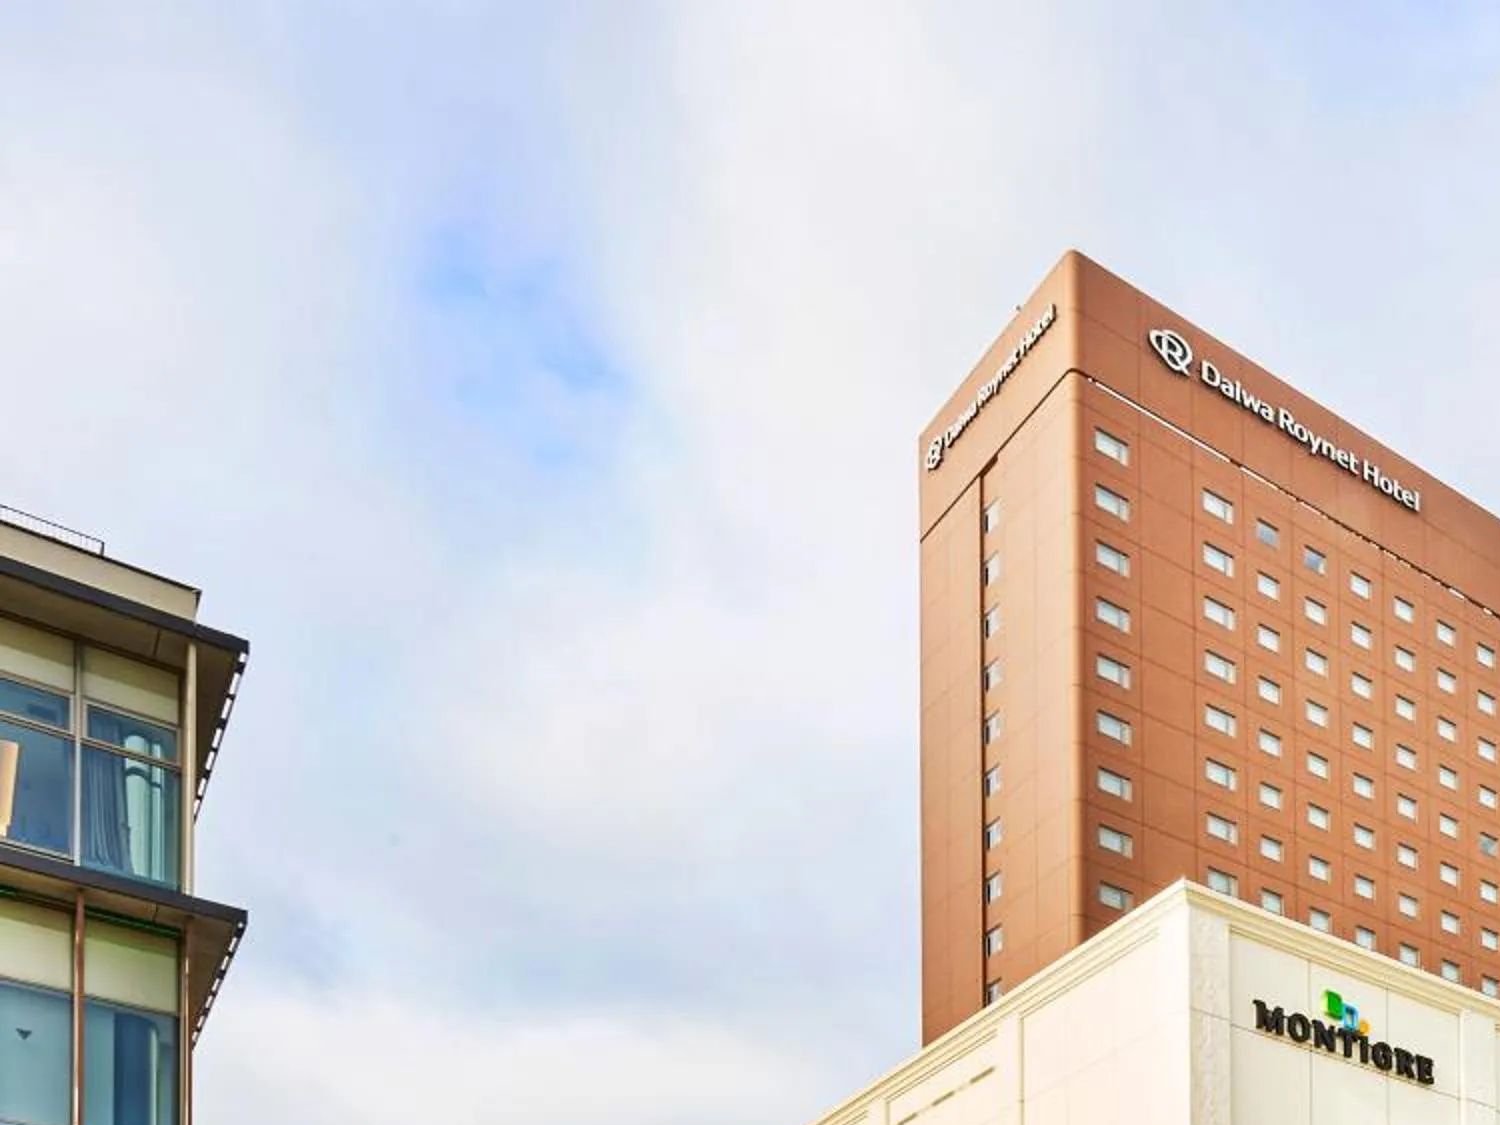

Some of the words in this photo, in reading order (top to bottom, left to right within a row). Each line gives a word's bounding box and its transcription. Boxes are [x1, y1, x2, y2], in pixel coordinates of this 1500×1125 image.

[1200, 359, 1275, 424] Daiwa
[1278, 407, 1360, 476] Roynet
[1362, 459, 1421, 513] Hotel
[1252, 998, 1435, 1085] MONTIGRE
